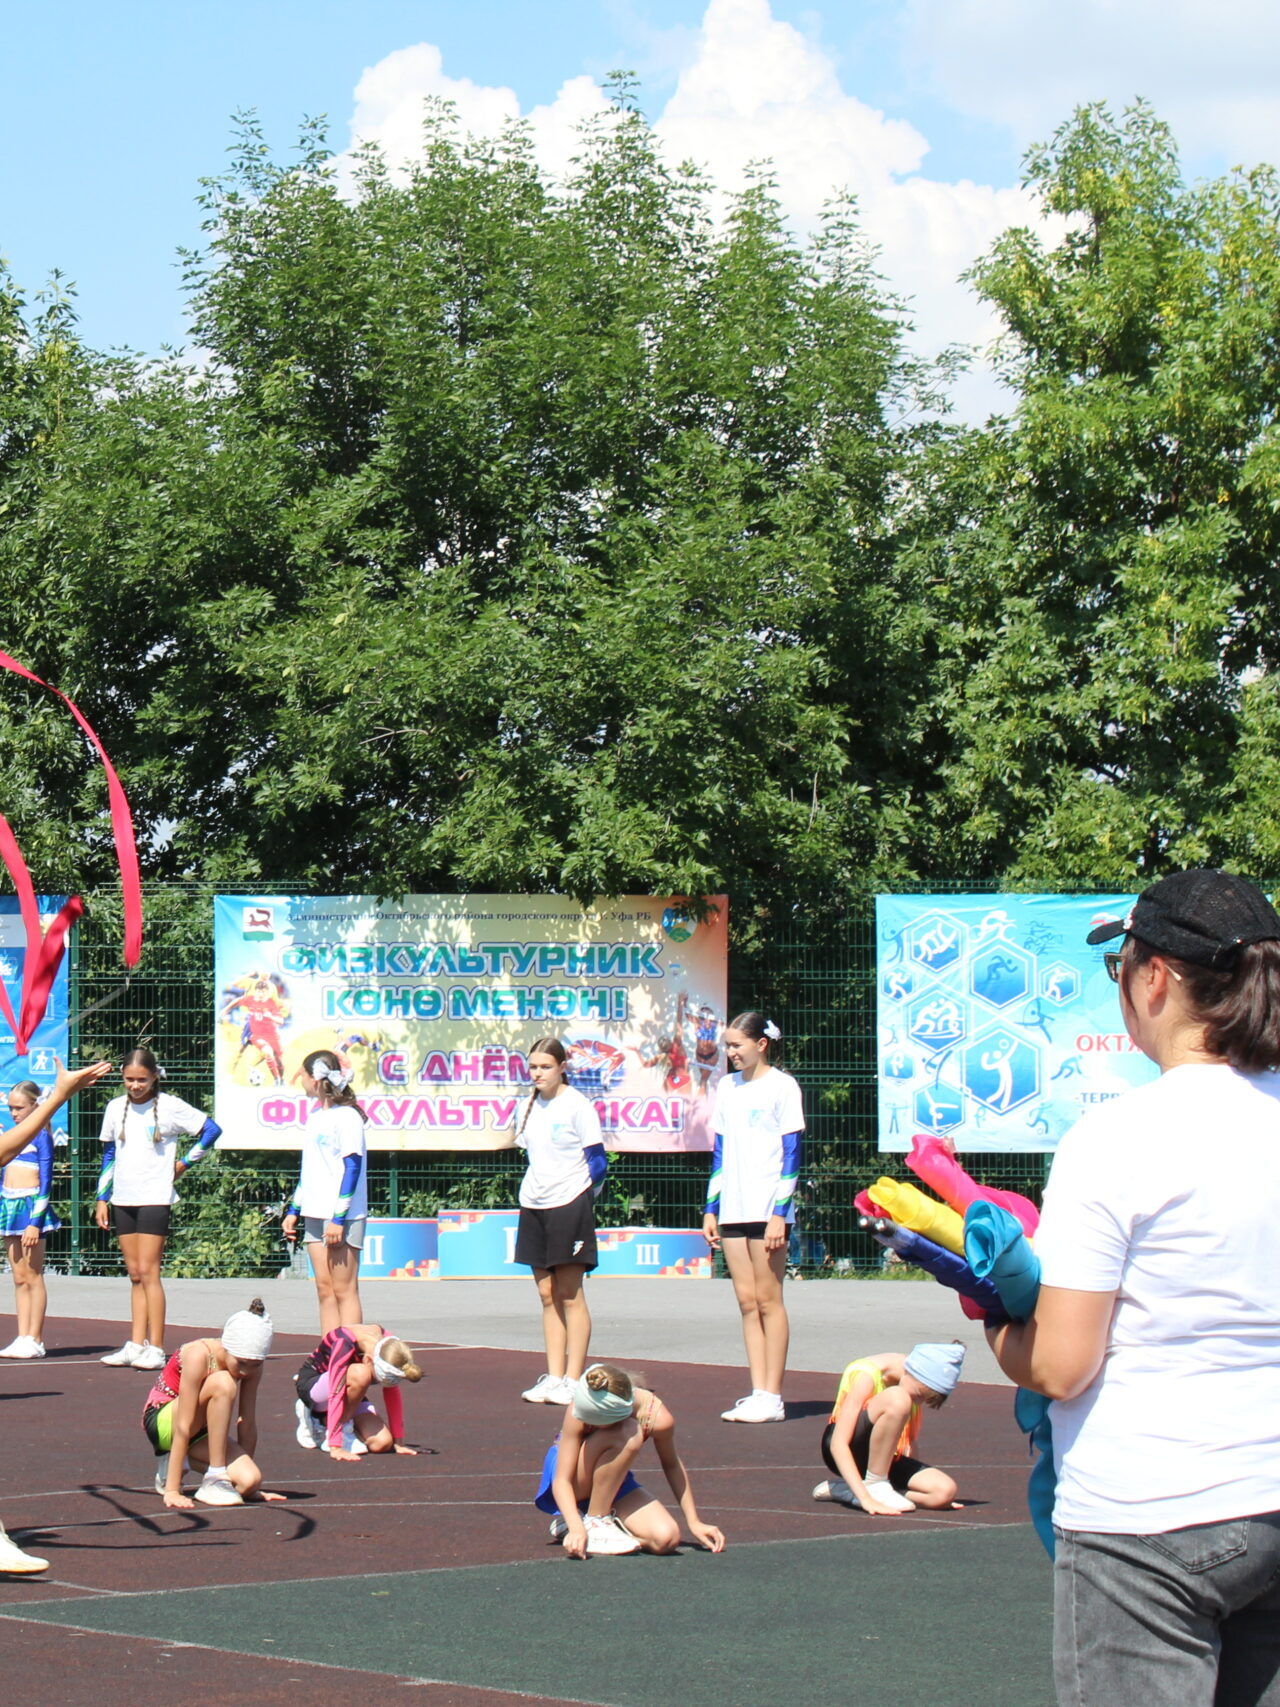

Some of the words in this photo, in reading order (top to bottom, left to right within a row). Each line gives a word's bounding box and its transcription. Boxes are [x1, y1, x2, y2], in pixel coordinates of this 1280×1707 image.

[496, 912, 559, 923] городского
[611, 911, 634, 922] Уфа
[636, 911, 652, 921] РБ
[280, 944, 662, 976] ФИЗКУЛЬТУРНИК
[324, 987, 443, 1018] КӨНӨ
[380, 1053, 407, 1082] С
[260, 1098, 682, 1129] ФИКУЛЬТУКА!
[363, 1235, 385, 1265] II
[635, 1244, 661, 1265] III
